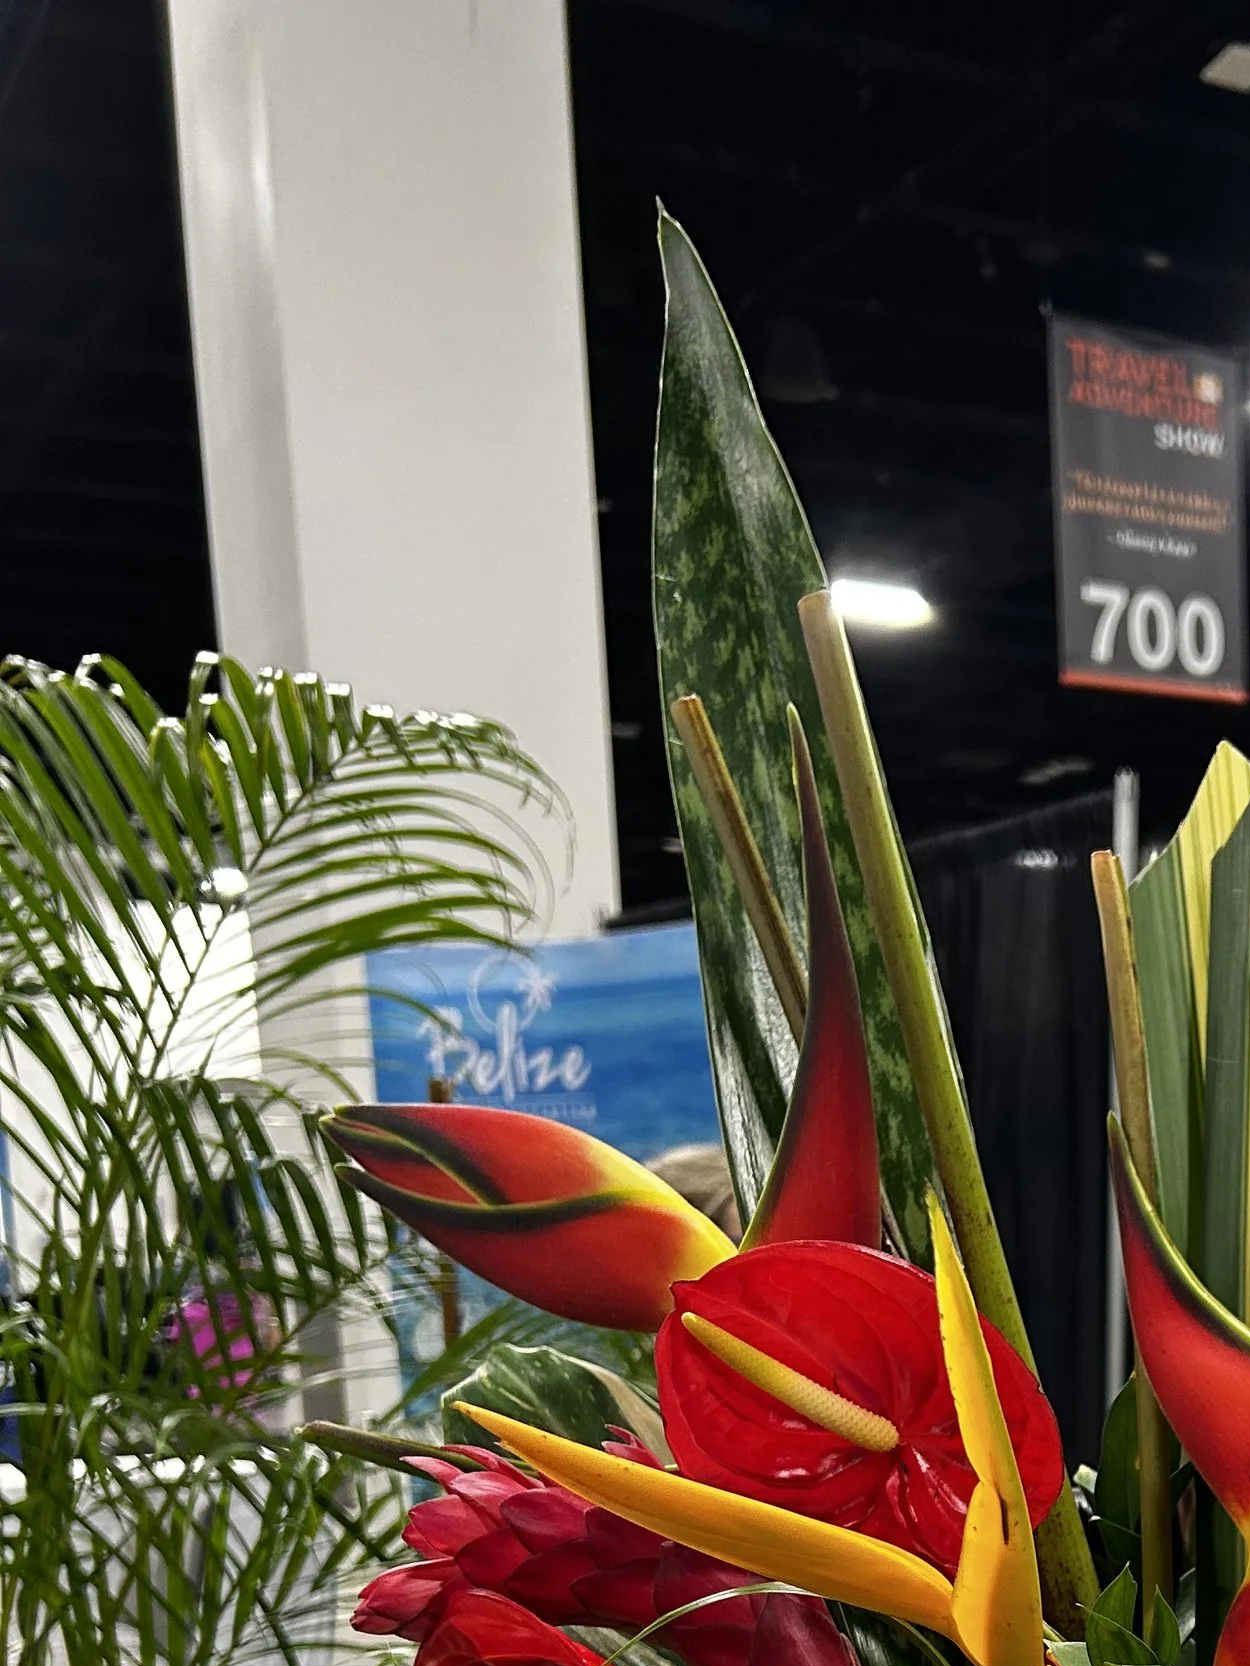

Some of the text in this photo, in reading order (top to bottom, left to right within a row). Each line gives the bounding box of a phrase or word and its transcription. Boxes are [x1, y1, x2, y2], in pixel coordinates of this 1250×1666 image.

[1067, 339, 1191, 397] TRAVEL
[1154, 422, 1224, 459] SHOW
[1080, 578, 1226, 676] 700
[416, 1002, 592, 1104] Belize
